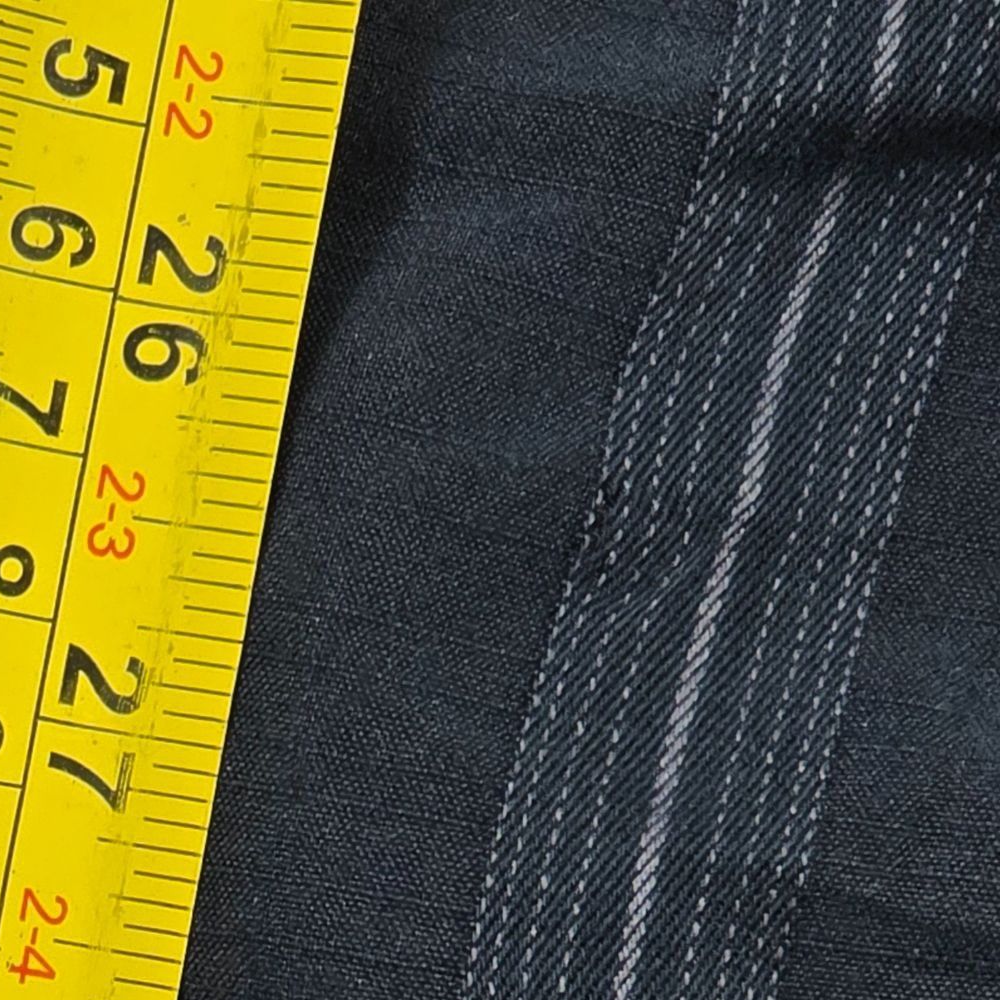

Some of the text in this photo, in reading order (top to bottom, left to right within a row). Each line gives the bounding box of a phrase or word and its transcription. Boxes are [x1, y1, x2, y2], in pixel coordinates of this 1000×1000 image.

[44, 39, 129, 103] 5
[165, 45, 223, 139] 2-2
[12, 206, 95, 266] 6
[122, 223, 227, 385] 26
[87, 465, 145, 559] 2-3
[49, 644, 145, 812] 27
[9, 887, 67, 983] 2-4
